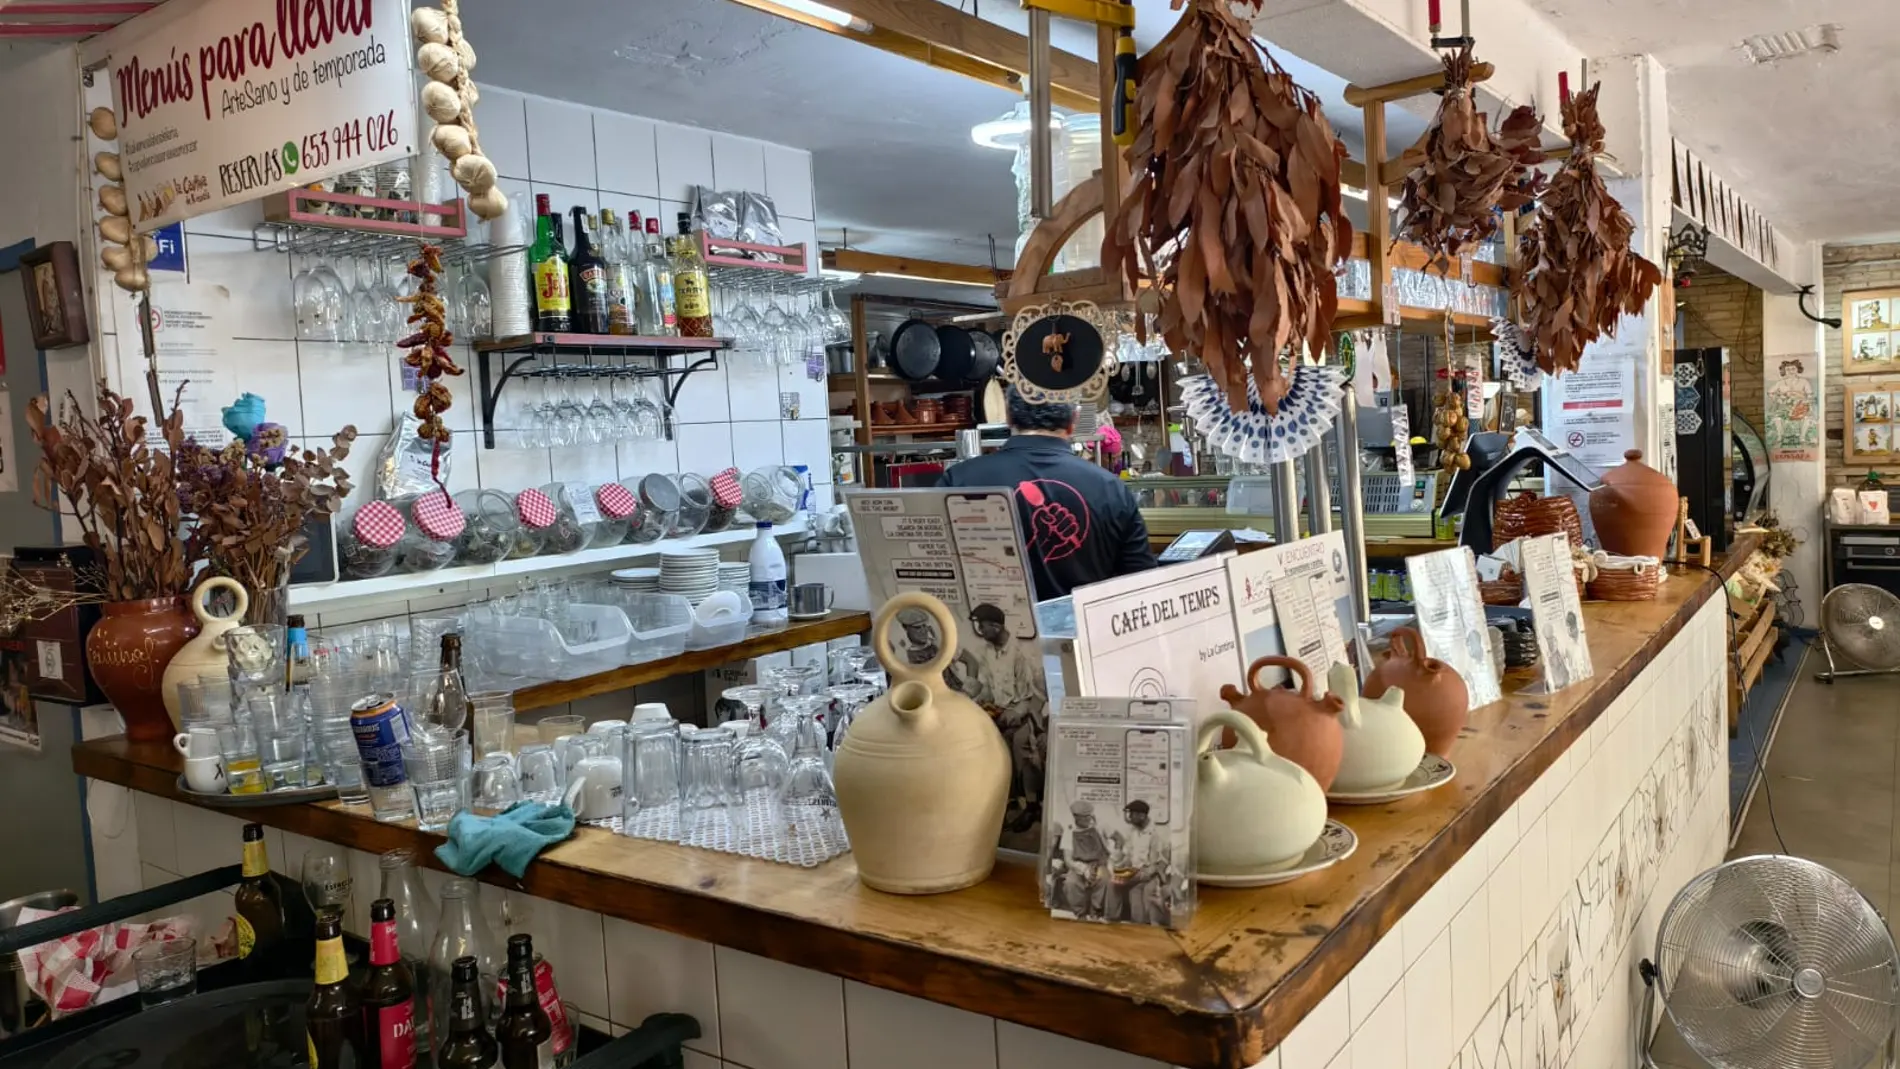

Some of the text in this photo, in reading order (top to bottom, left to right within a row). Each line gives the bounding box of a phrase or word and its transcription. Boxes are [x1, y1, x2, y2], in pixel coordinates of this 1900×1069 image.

[116, 46, 194, 128] Menús
[200, 22, 276, 120] para
[222, 35, 386, 118] ArteSano y de temporada
[219, 149, 283, 197] RESERVAS
[302, 131, 330, 170] 653
[333, 118, 362, 158] 944
[366, 109, 399, 152] 026
[1111, 586, 1220, 637] CAFÉ DEL TEMPS
[1199, 648, 1207, 661] by
[1215, 639, 1235, 655] Cantina
